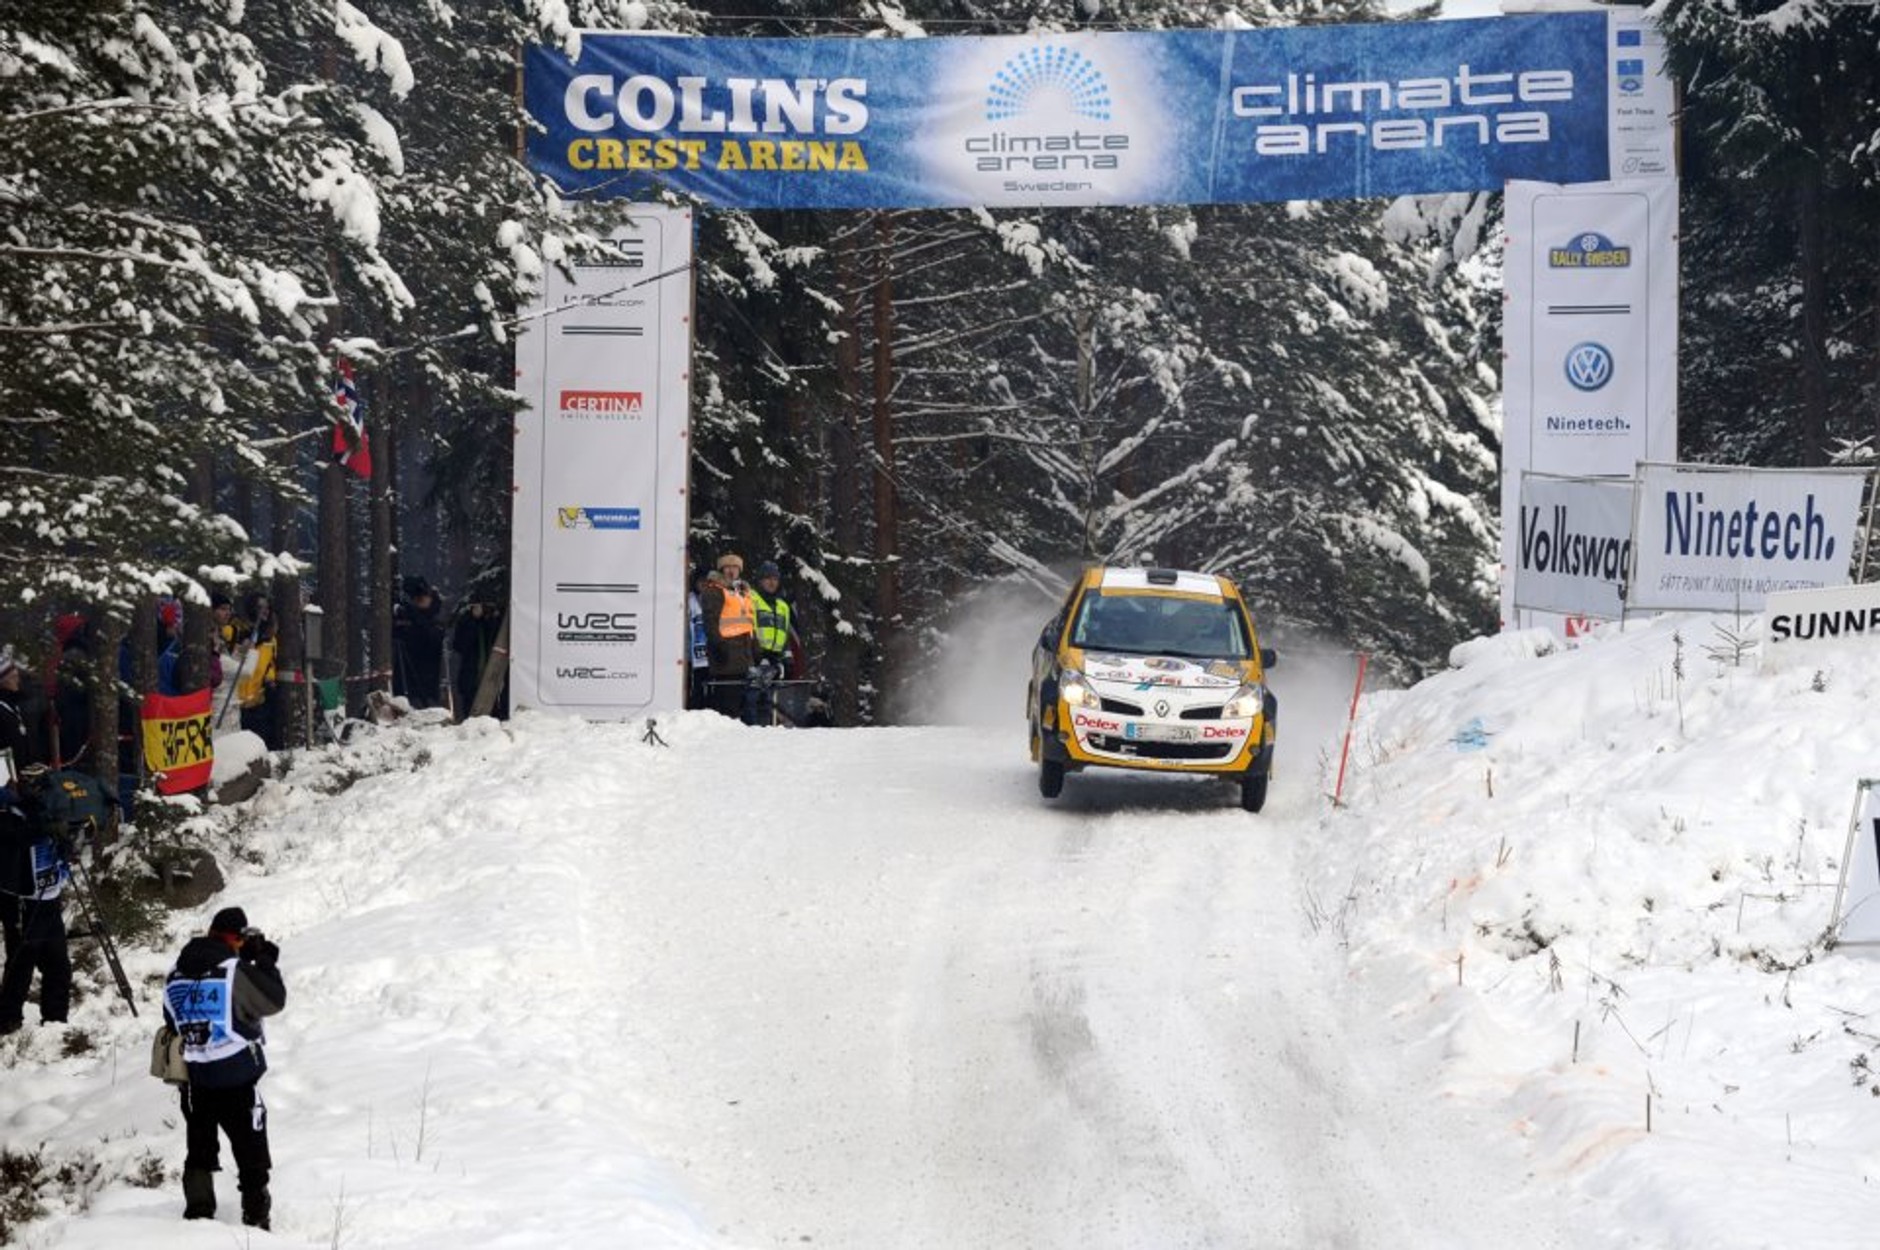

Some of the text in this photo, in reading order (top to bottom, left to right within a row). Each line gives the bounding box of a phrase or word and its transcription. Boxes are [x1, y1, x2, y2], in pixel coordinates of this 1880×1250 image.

[1232, 64, 1573, 117] climate
[564, 74, 869, 134] COLIN'S
[965, 130, 1129, 152] climate
[1255, 111, 1549, 155] arena
[567, 138, 869, 170] CREST ARENA
[976, 154, 1118, 171] arena
[1003, 180, 1092, 191] Sweden
[1552, 249, 1628, 265] RALLY SWEDEN
[566, 397, 640, 413] CERTINA
[1547, 415, 1631, 431] Ninetech.
[1664, 490, 1836, 561] Ninetech.
[558, 612, 637, 630] WRC
